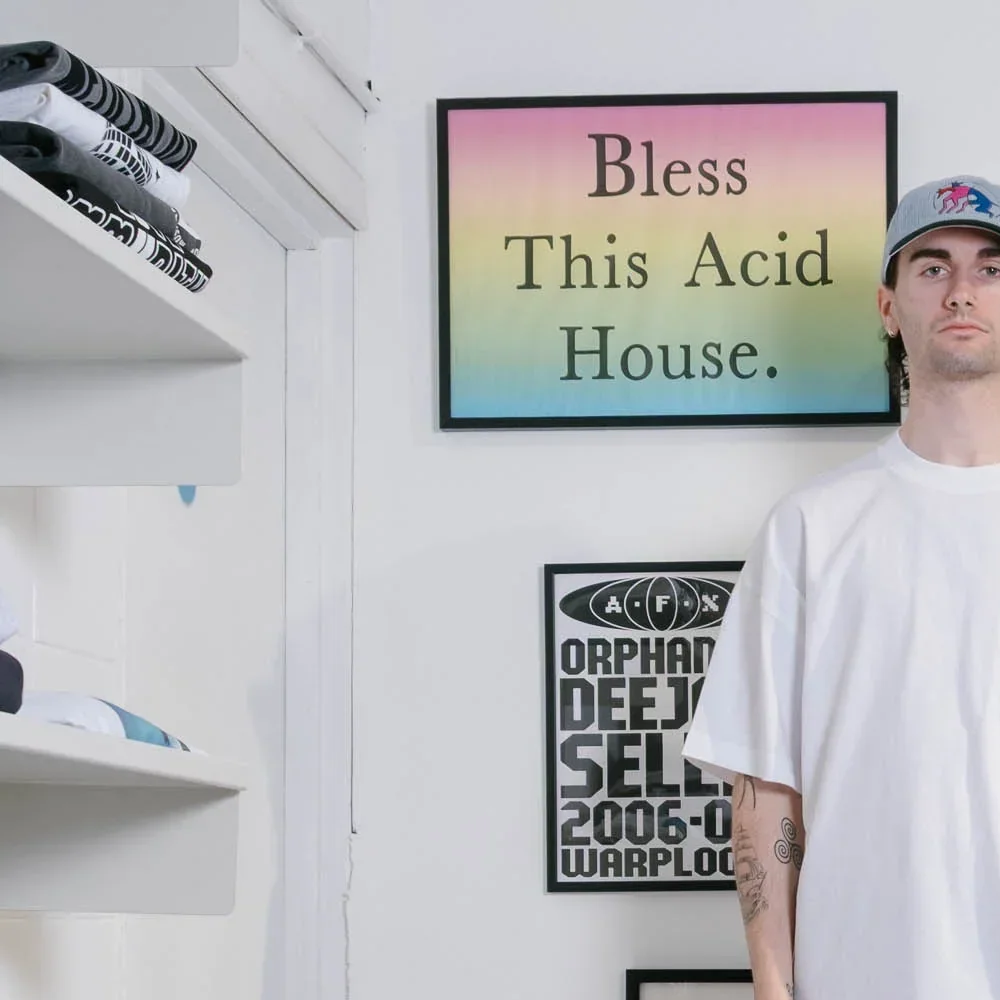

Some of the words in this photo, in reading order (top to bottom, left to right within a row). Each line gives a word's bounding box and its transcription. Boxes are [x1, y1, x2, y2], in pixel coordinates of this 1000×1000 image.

[587, 133, 748, 198] Bless
[504, 233, 649, 290] This
[684, 228, 833, 288] Acid
[559, 325, 778, 382] House.
